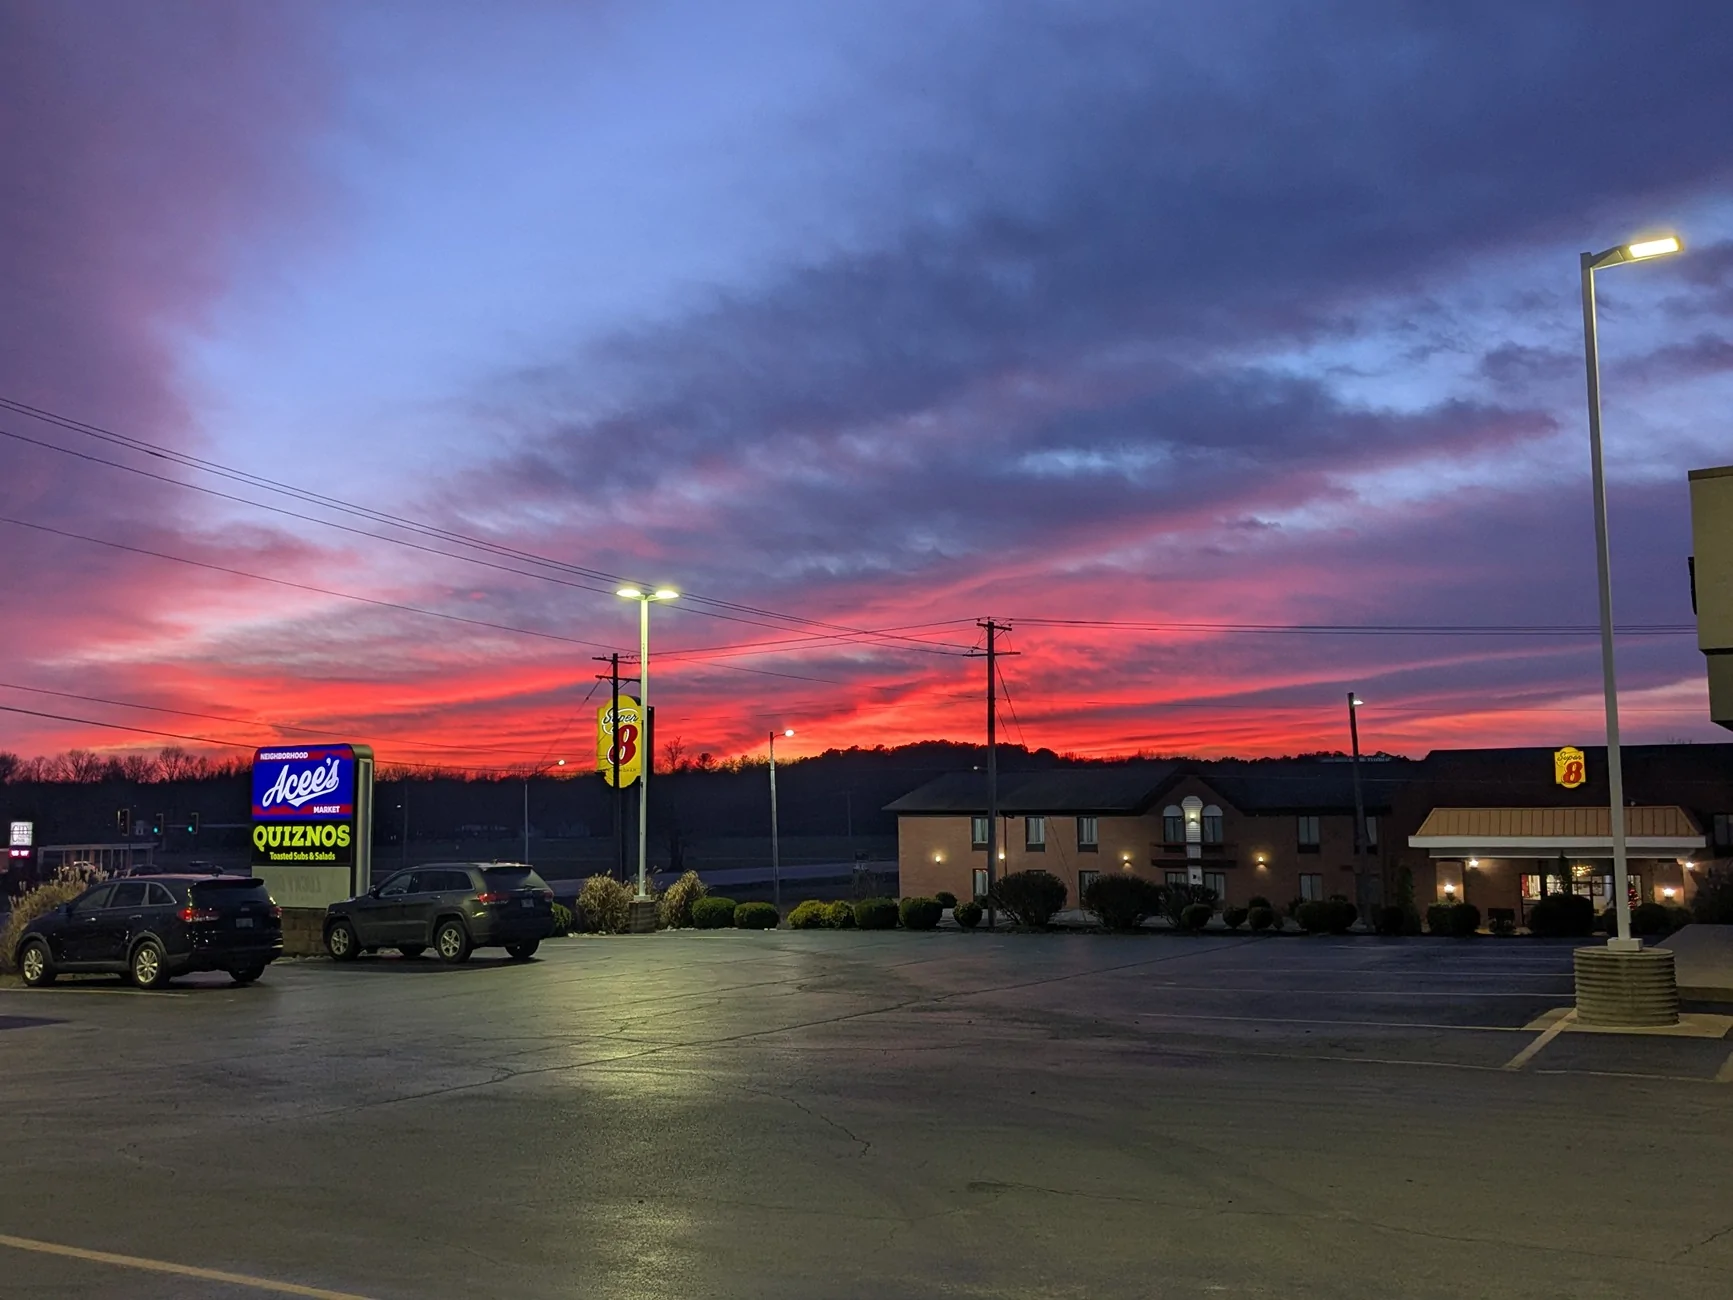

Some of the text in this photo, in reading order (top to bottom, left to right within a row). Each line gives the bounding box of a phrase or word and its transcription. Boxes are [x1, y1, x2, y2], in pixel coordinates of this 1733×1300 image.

[607, 724, 638, 766] 8
[260, 752, 309, 760] NEIGHBORHOOD
[1557, 751, 1583, 766] Super
[262, 757, 340, 807] Acee's
[1562, 761, 1583, 784] 8
[313, 805, 340, 814] MARKET
[253, 825, 350, 852] QUIZNOS
[270, 852, 335, 860] Toasted Subs & Salads
